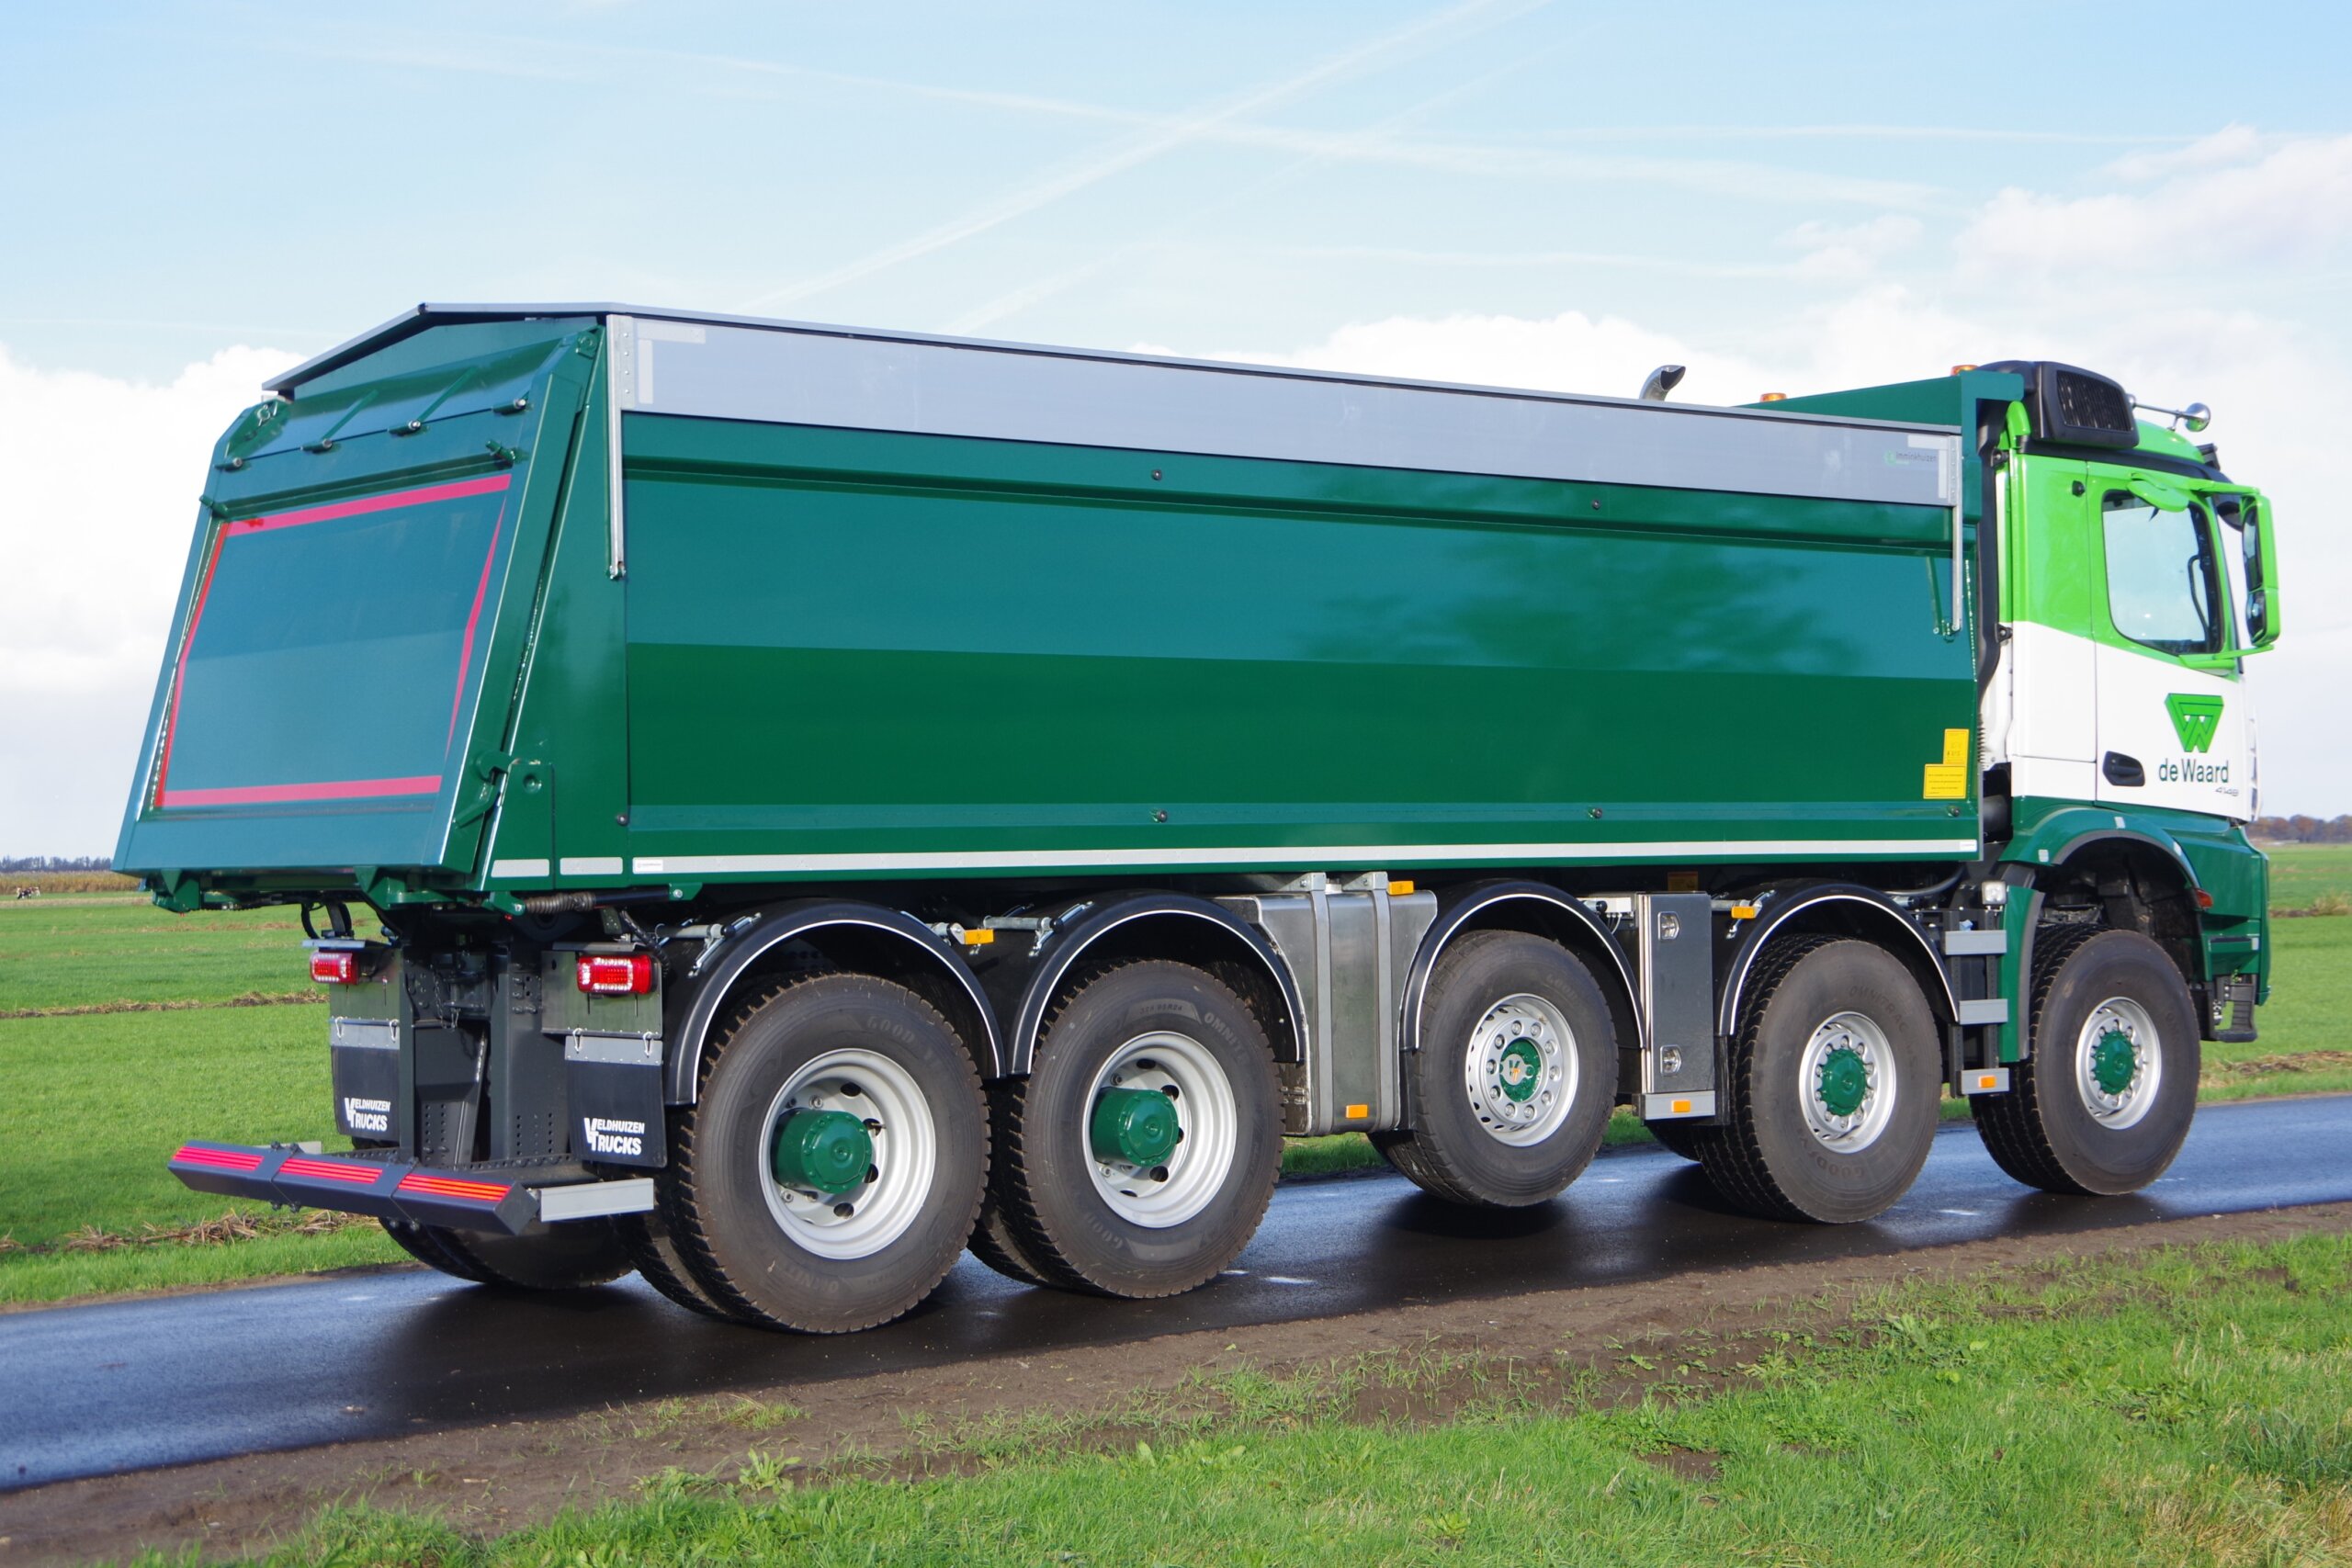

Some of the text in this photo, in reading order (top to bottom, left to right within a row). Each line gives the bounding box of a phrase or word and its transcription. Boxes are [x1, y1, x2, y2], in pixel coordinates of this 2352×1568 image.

[2159, 758, 2229, 784] de Waard
[345, 1098, 391, 1122] VELDHUIZEN
[349, 1109, 388, 1132] TRUCKS
[584, 1117, 645, 1144] VELDHUIZEN
[589, 1131, 642, 1156] TRUCKS
